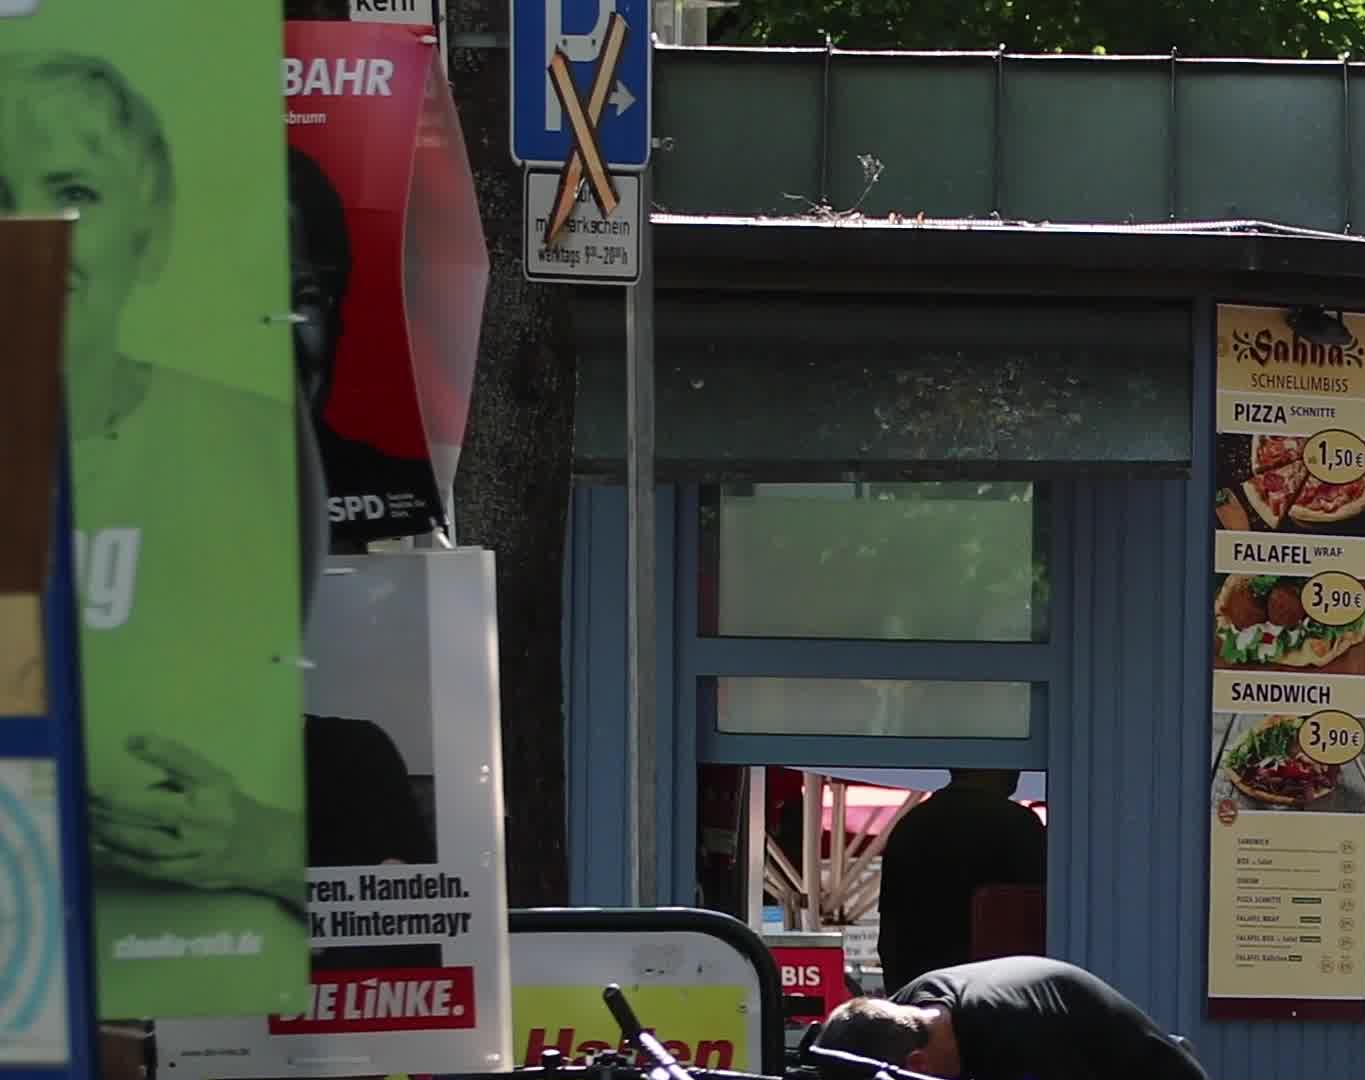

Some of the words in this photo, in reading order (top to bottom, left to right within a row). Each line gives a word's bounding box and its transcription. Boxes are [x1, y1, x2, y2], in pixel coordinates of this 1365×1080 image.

[280, 57, 395, 97] BAHR
[545, 0, 616, 131] P
[563, 216, 631, 236] arkschein
[1251, 372, 1349, 393] SCHNELLIMBISS
[1234, 403, 1287, 424] PIZZA
[1290, 405, 1336, 418] SCHNITTE
[328, 495, 385, 522] SPD
[1234, 543, 1311, 565] FALAFEL
[1231, 682, 1331, 705] SANDWICH
[307, 878, 355, 902] ren.
[359, 872, 470, 901] Handeln.
[330, 910, 472, 938] Hintermayr
[781, 966, 821, 987] BIS
[279, 982, 339, 1022] IE
